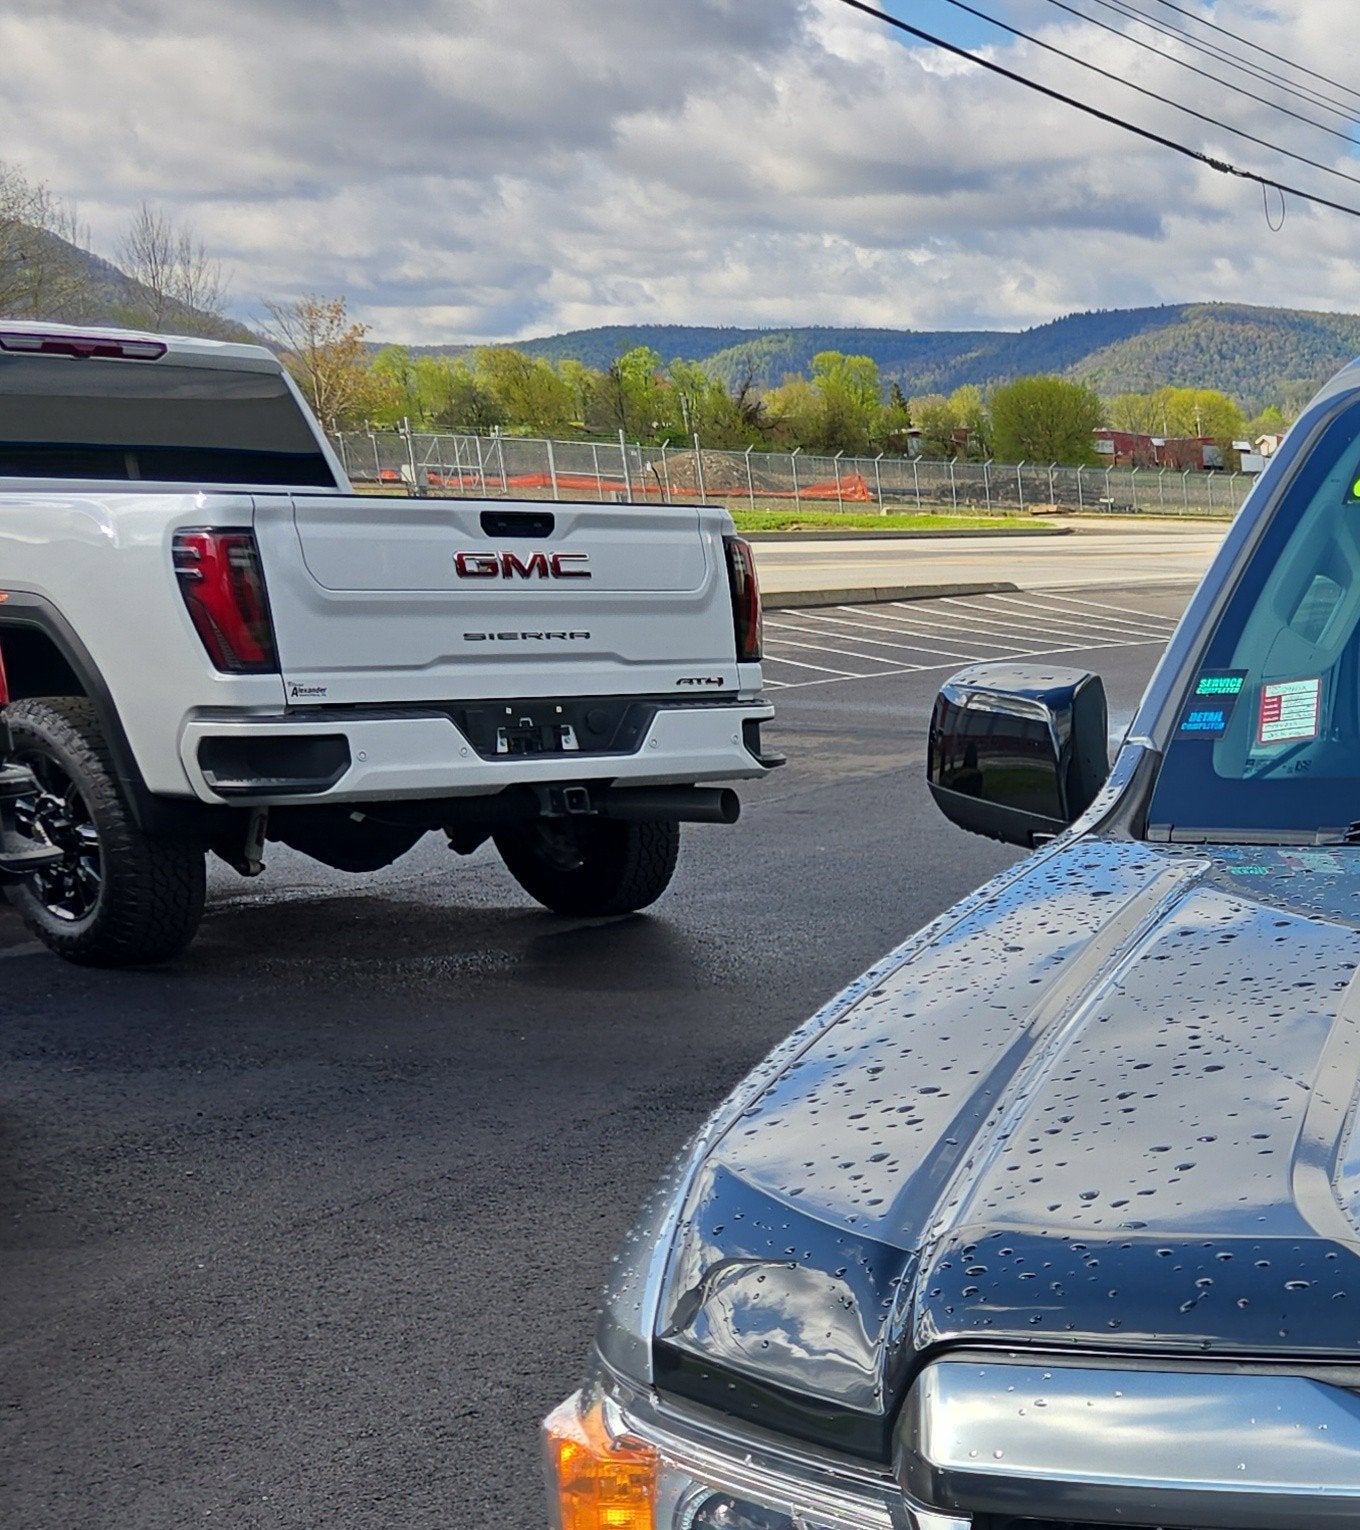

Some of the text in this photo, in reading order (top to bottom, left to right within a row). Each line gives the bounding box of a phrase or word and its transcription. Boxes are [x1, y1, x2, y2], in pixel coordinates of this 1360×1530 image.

[453, 550, 592, 580] GMC
[462, 631, 591, 641] SIERRA
[675, 676, 724, 687] AT4
[1199, 677, 1244, 688] SERVICE
[291, 686, 327, 697] Alexander
[1188, 710, 1224, 722] DETAIL
